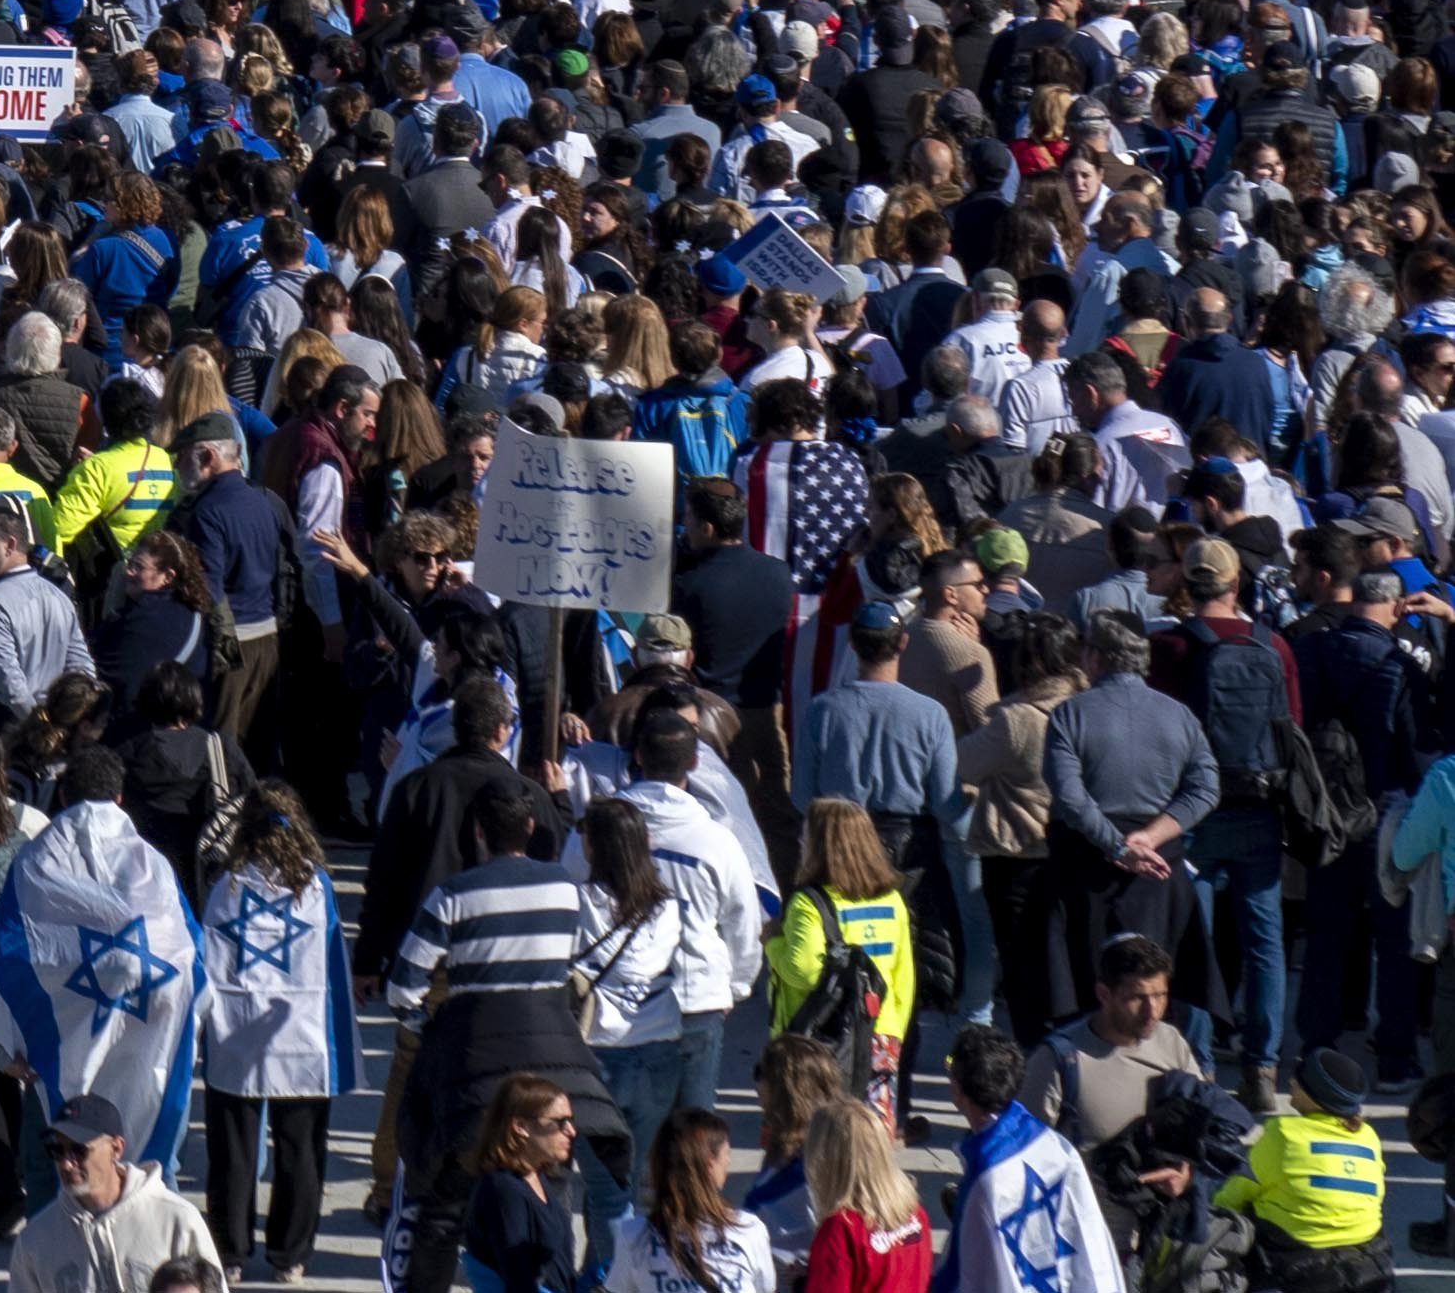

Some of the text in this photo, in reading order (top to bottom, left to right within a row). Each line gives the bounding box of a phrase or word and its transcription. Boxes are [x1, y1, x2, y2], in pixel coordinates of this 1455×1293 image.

[20, 66, 63, 88] THEM
[758, 249, 789, 282] WITH
[767, 241, 812, 284] STANDS
[777, 233, 822, 276] DALLAS
[982, 342, 1017, 359] AJC
